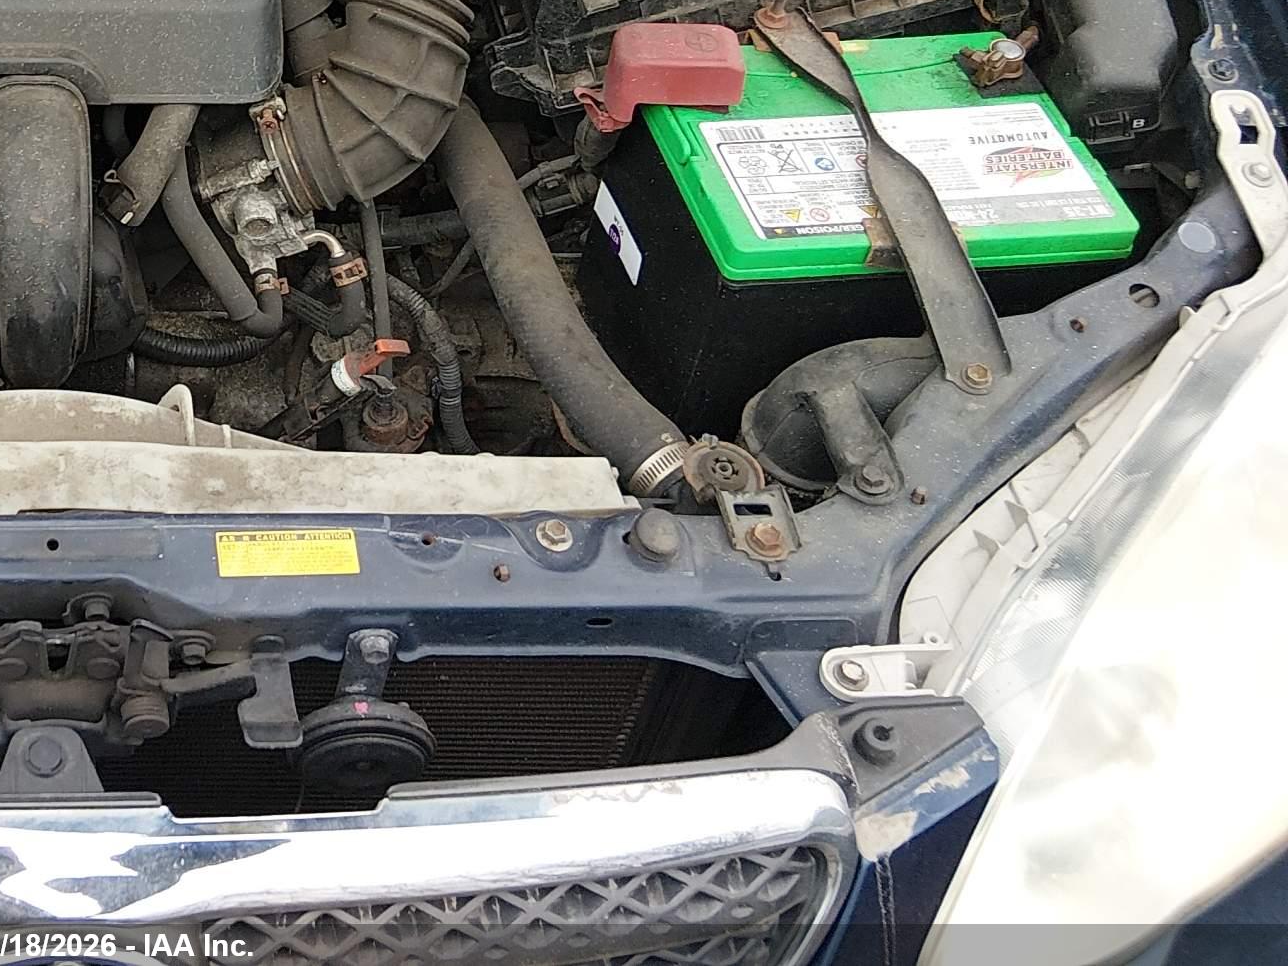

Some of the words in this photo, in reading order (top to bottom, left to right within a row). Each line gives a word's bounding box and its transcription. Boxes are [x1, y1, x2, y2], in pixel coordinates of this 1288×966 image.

[1132, 119, 1145, 129] B
[968, 131, 1048, 146] AUTOMOTIVE
[985, 151, 1063, 165] BATTERIES
[984, 160, 1072, 173] INTERSTATE
[304, 532, 350, 540] ATTENTION
